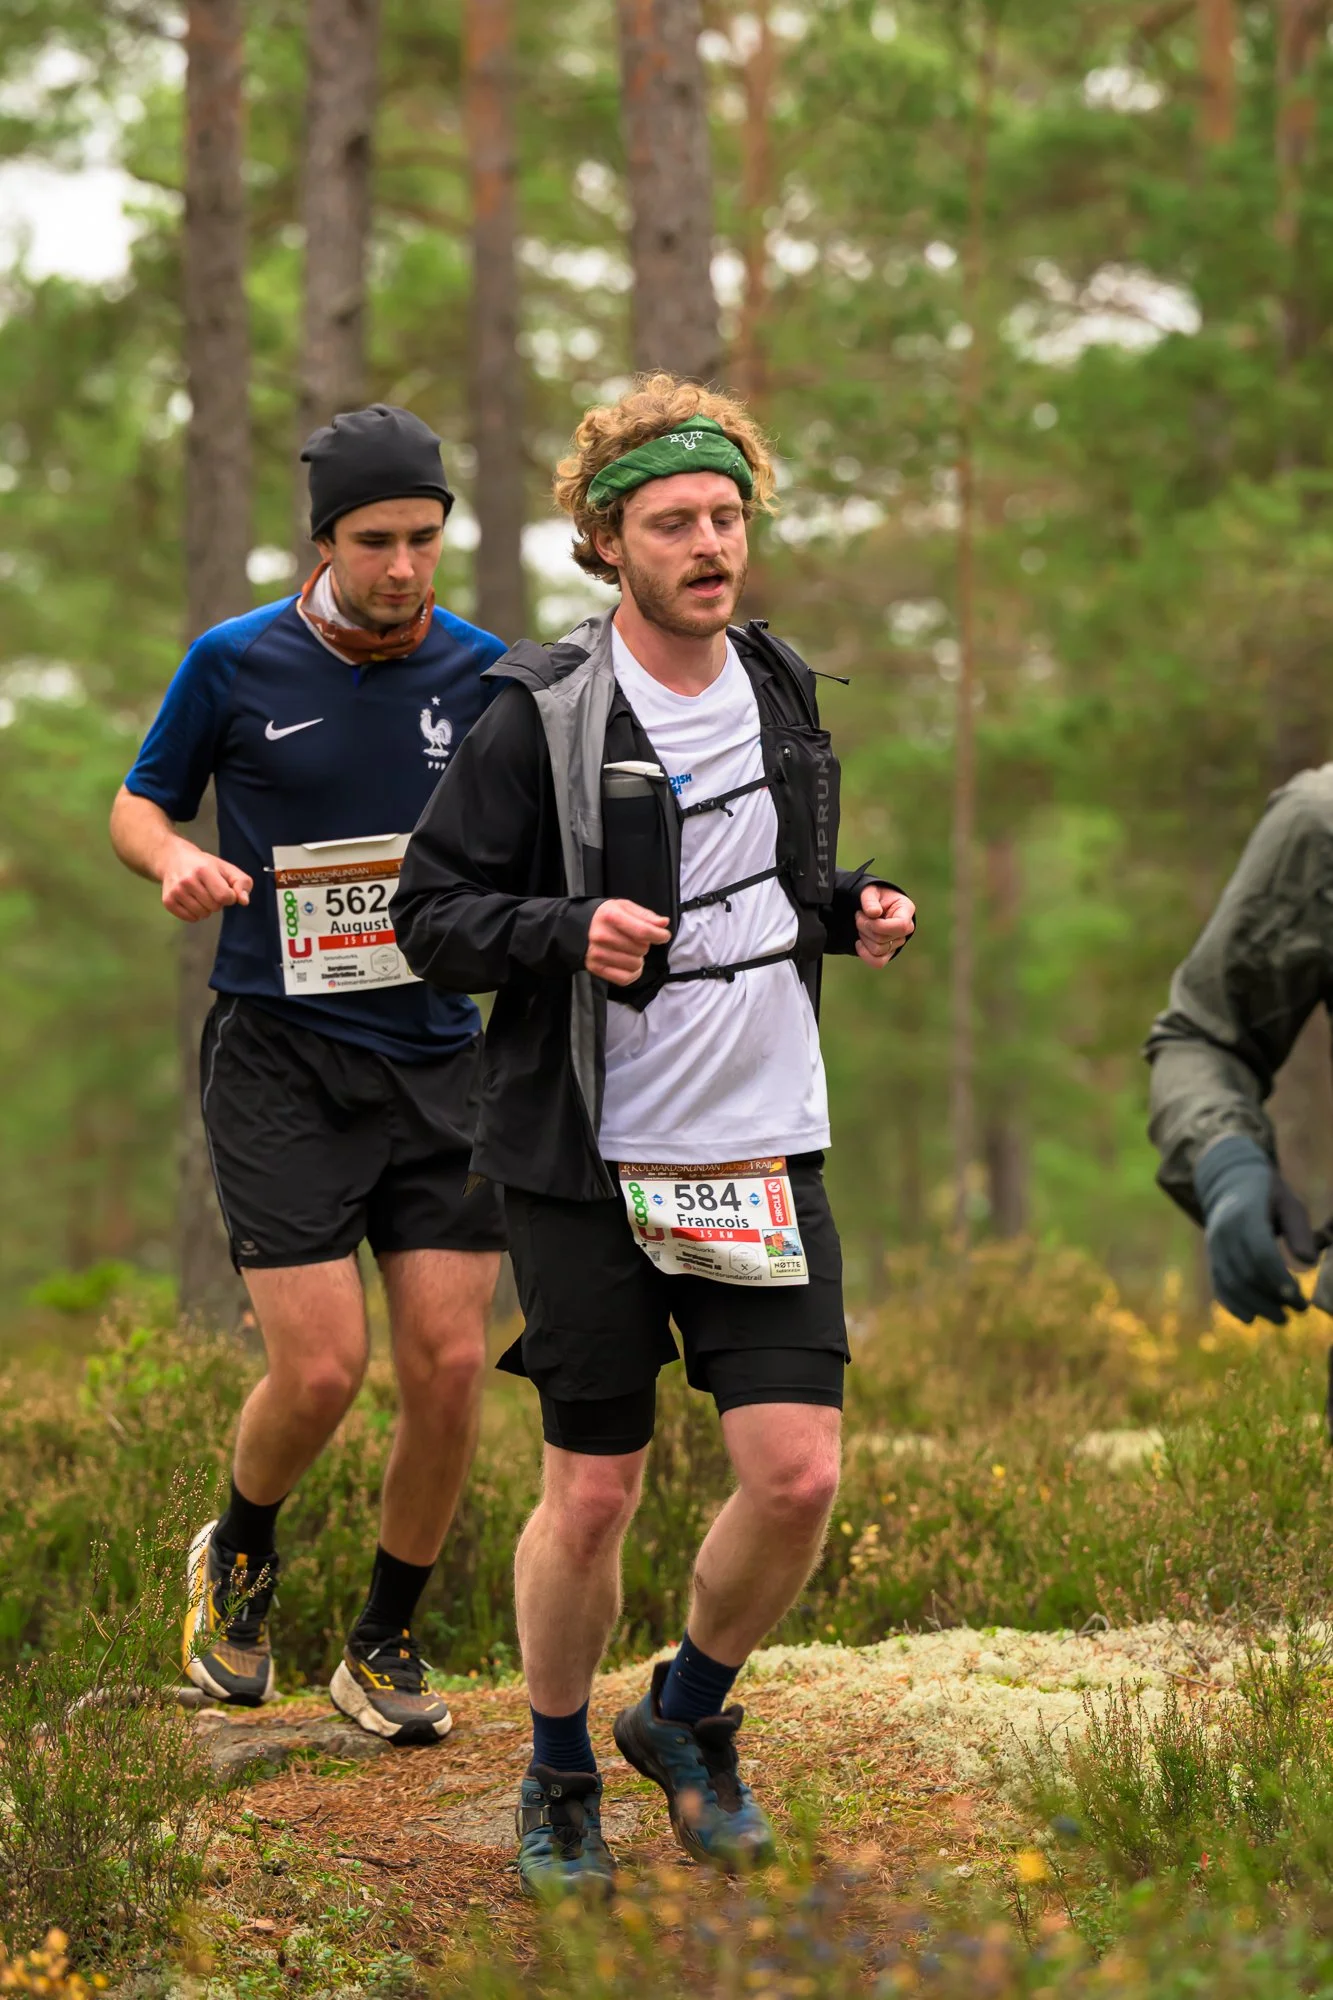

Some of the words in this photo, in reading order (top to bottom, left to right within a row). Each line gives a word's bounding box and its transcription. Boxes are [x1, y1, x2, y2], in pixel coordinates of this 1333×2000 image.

[816, 753, 830, 888] KIPRUN
[284, 891, 298, 937] coop
[326, 884, 388, 917] 562
[331, 917, 388, 935] August
[344, 936, 356, 945] 15
[362, 934, 377, 944] KM
[628, 1182, 648, 1226] coop
[675, 1182, 742, 1211] 584
[771, 1194, 784, 1223] CIRCLE
[677, 1213, 749, 1228] Francois
[700, 1229, 712, 1238] 15
[719, 1231, 734, 1239] KM
